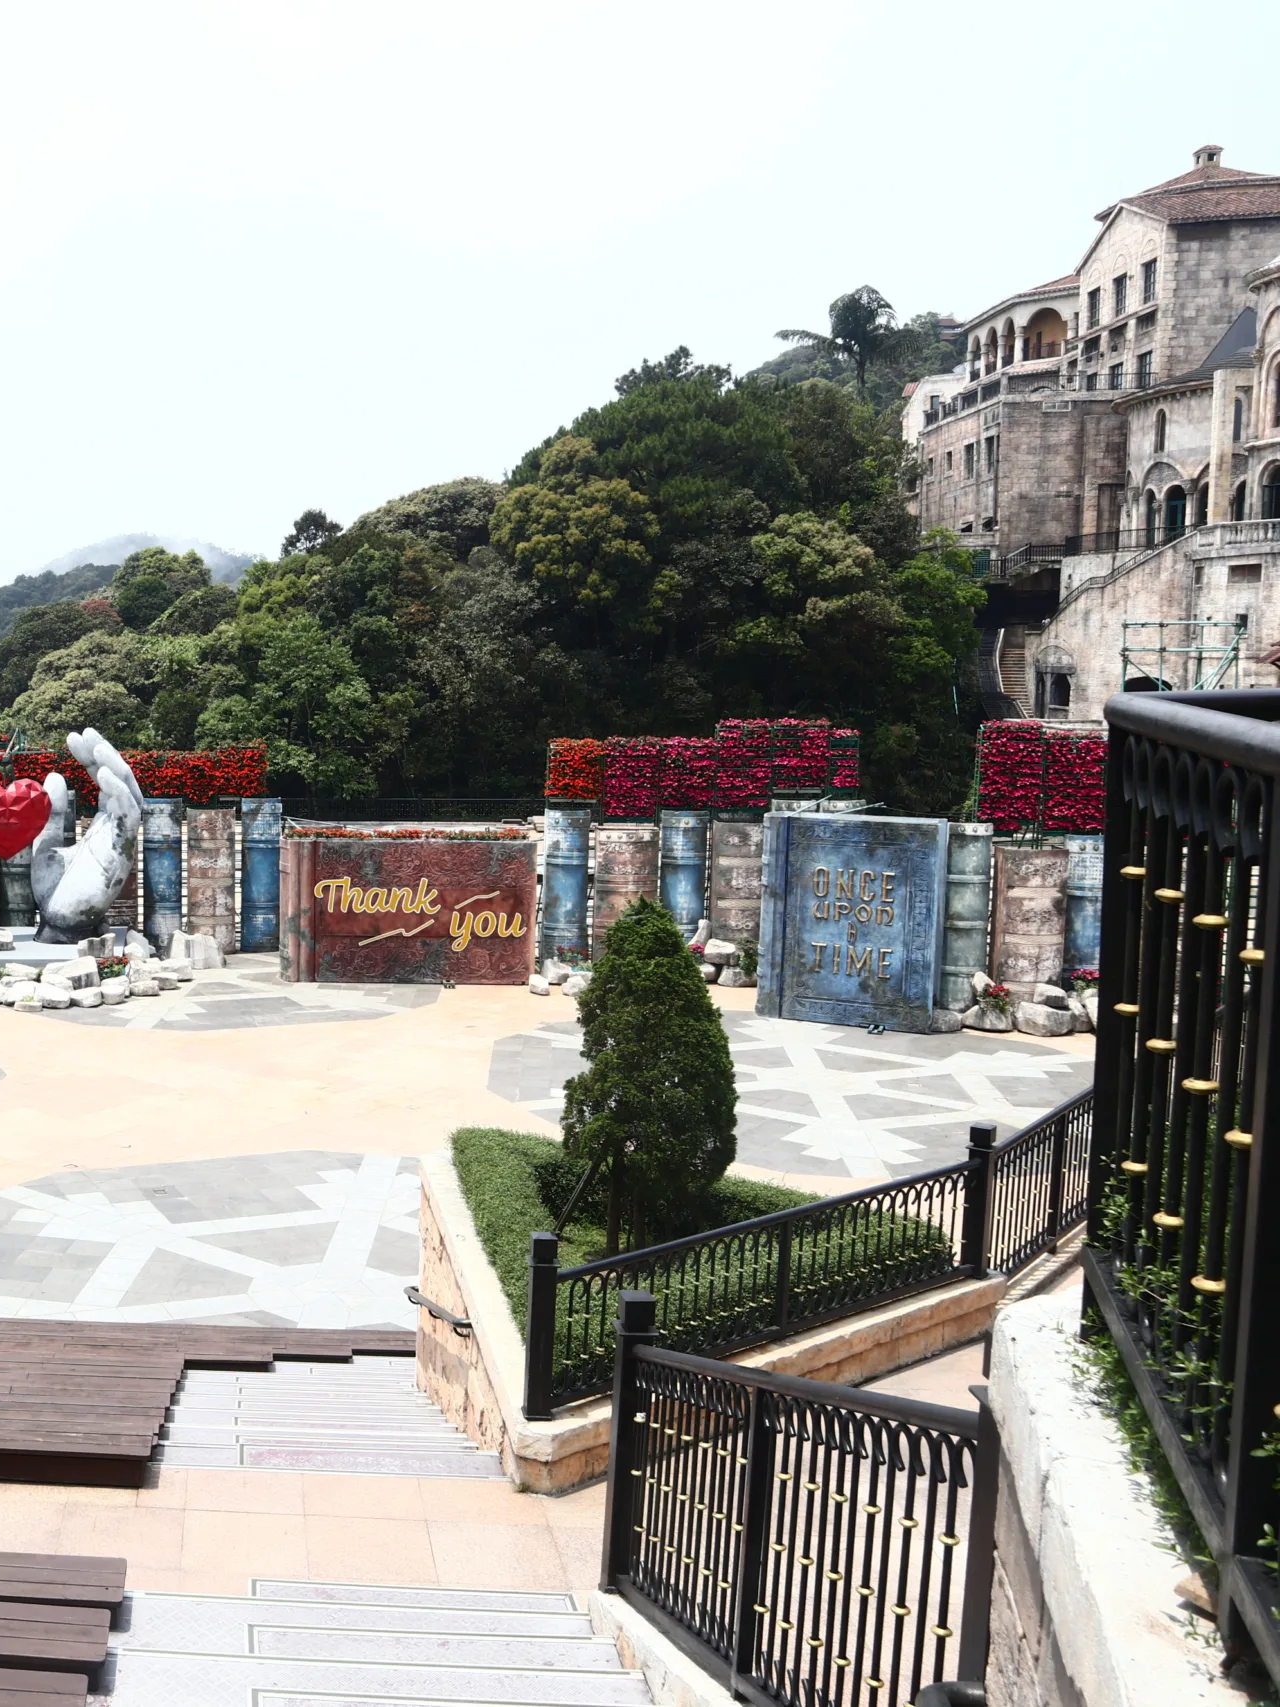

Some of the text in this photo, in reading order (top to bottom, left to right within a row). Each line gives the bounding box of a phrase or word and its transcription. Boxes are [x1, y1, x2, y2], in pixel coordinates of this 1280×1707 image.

[313, 876, 441, 914] Thank
[812, 866, 896, 903] ONCE
[449, 909, 527, 951] you
[811, 942, 893, 979] TIME
